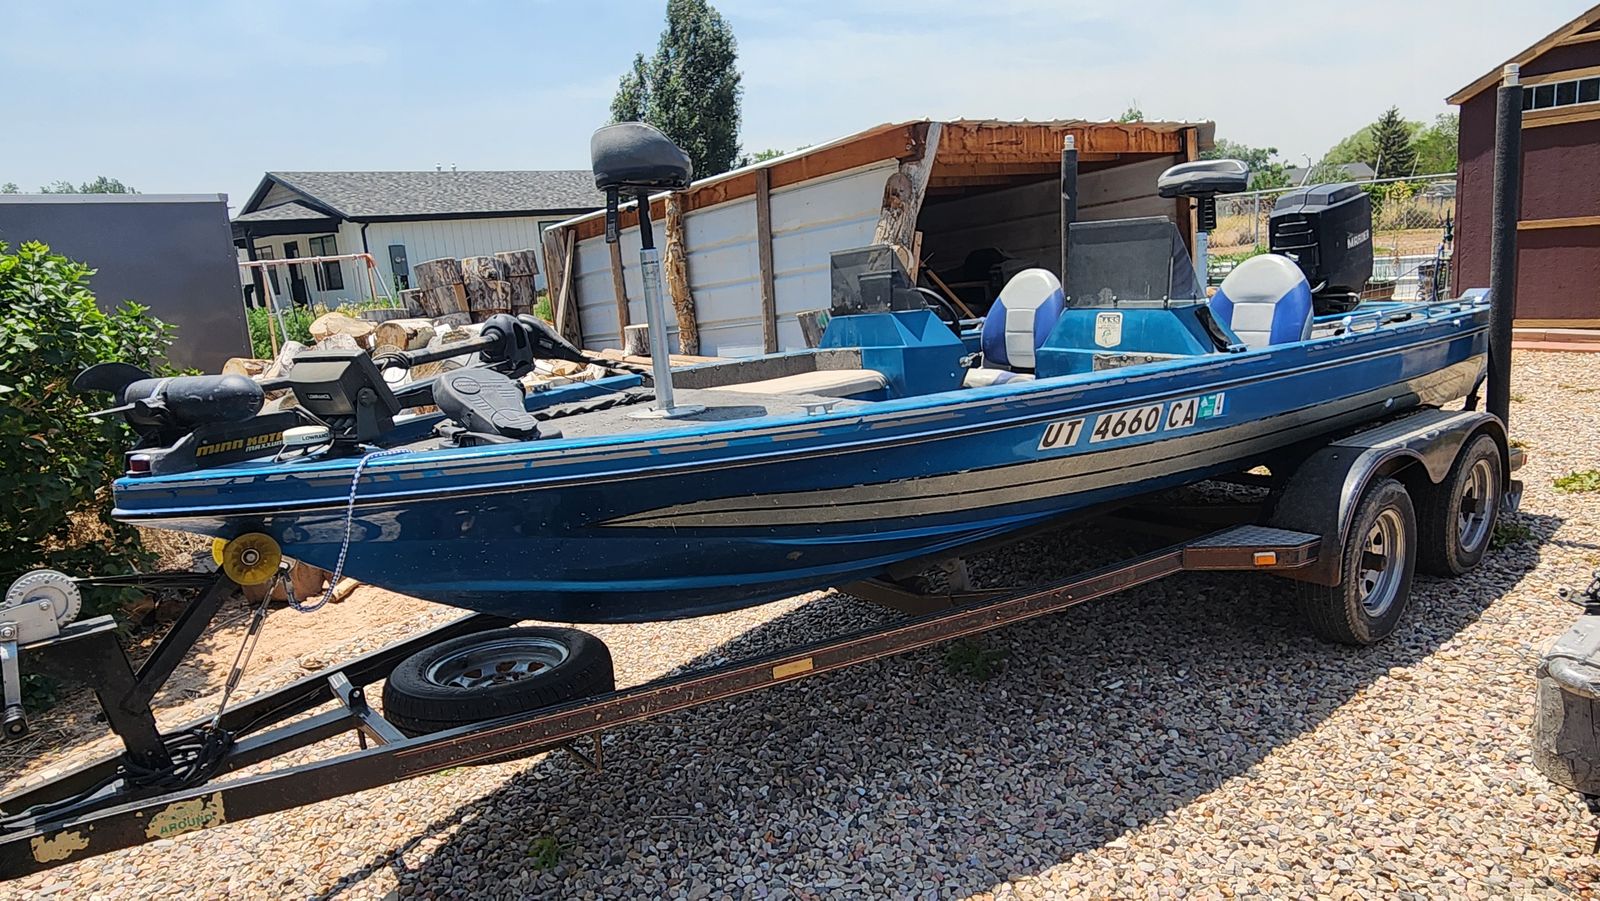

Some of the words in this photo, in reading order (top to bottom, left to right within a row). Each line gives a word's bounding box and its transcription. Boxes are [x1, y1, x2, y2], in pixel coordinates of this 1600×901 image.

[1042, 420, 1082, 447] UT
[1094, 406, 1160, 440] 4660
[1168, 399, 1195, 428] CA
[160, 814, 213, 834] AROUND
